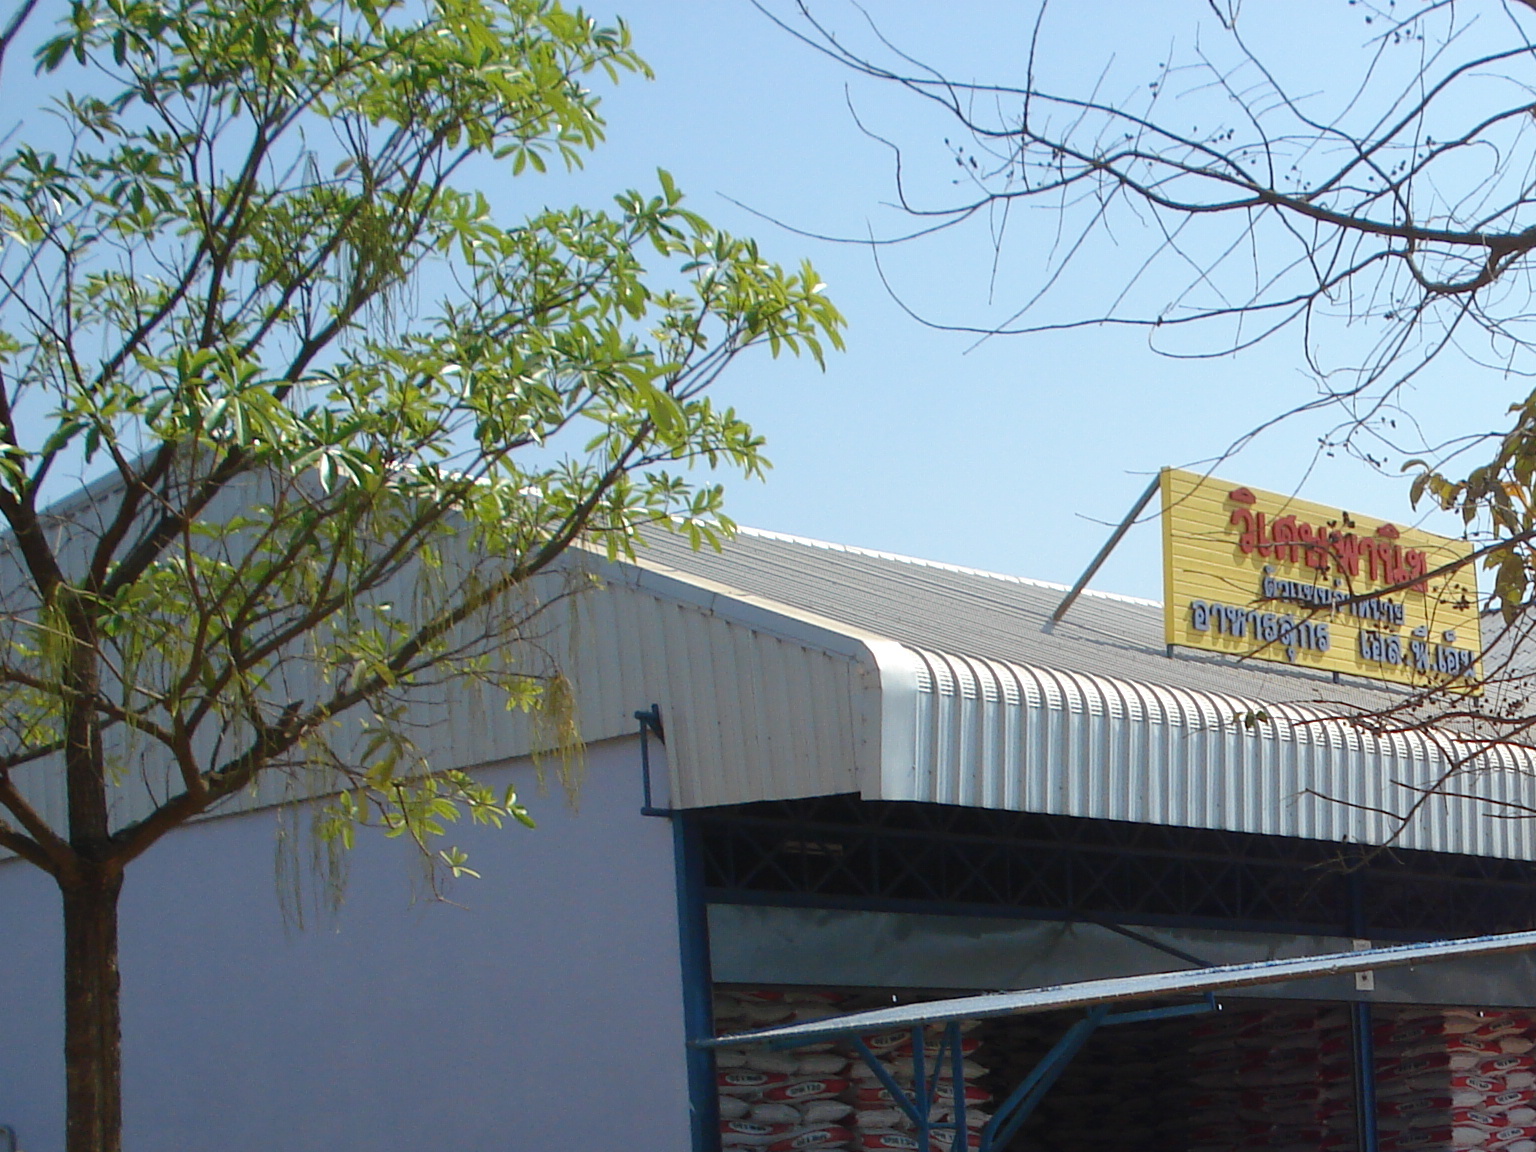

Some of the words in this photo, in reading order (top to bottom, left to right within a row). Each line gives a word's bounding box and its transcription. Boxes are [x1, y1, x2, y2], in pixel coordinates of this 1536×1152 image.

[1263, 565, 1406, 626] ตัวแทนจำหนาย
[1191, 599, 1331, 663] อาหารสุกร
